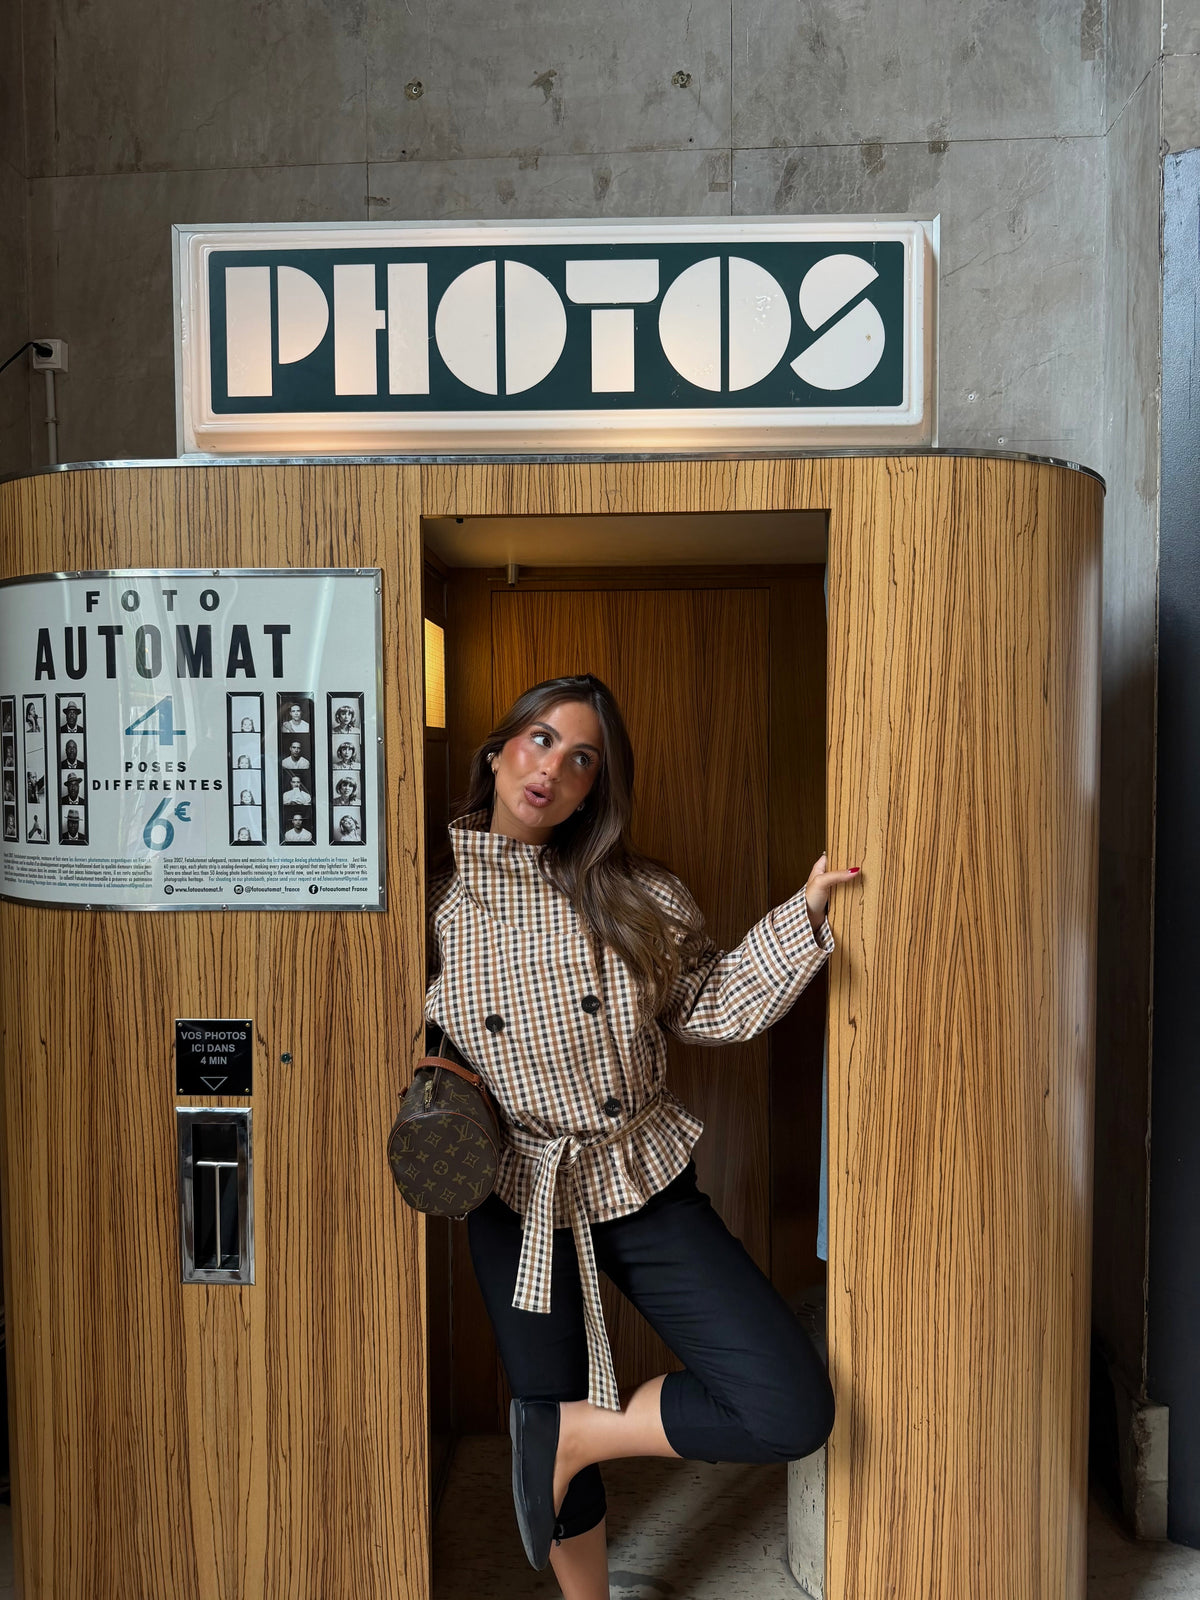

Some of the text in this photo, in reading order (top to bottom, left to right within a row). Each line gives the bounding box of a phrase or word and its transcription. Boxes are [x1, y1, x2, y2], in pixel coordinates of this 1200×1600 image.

[225, 253, 886, 398] PHOTOS
[86, 589, 221, 612] FOTO
[34, 624, 291, 680] AUTOMAT
[125, 695, 187, 746] 4
[125, 761, 187, 773] POSES
[92, 779, 223, 791] DIFFERENTES
[142, 797, 191, 851] 6€
[181, 1031, 247, 1040] VOS PHOTOS
[191, 1043, 236, 1053] ICI DANS
[200, 1056, 228, 1065] 4 MIN
